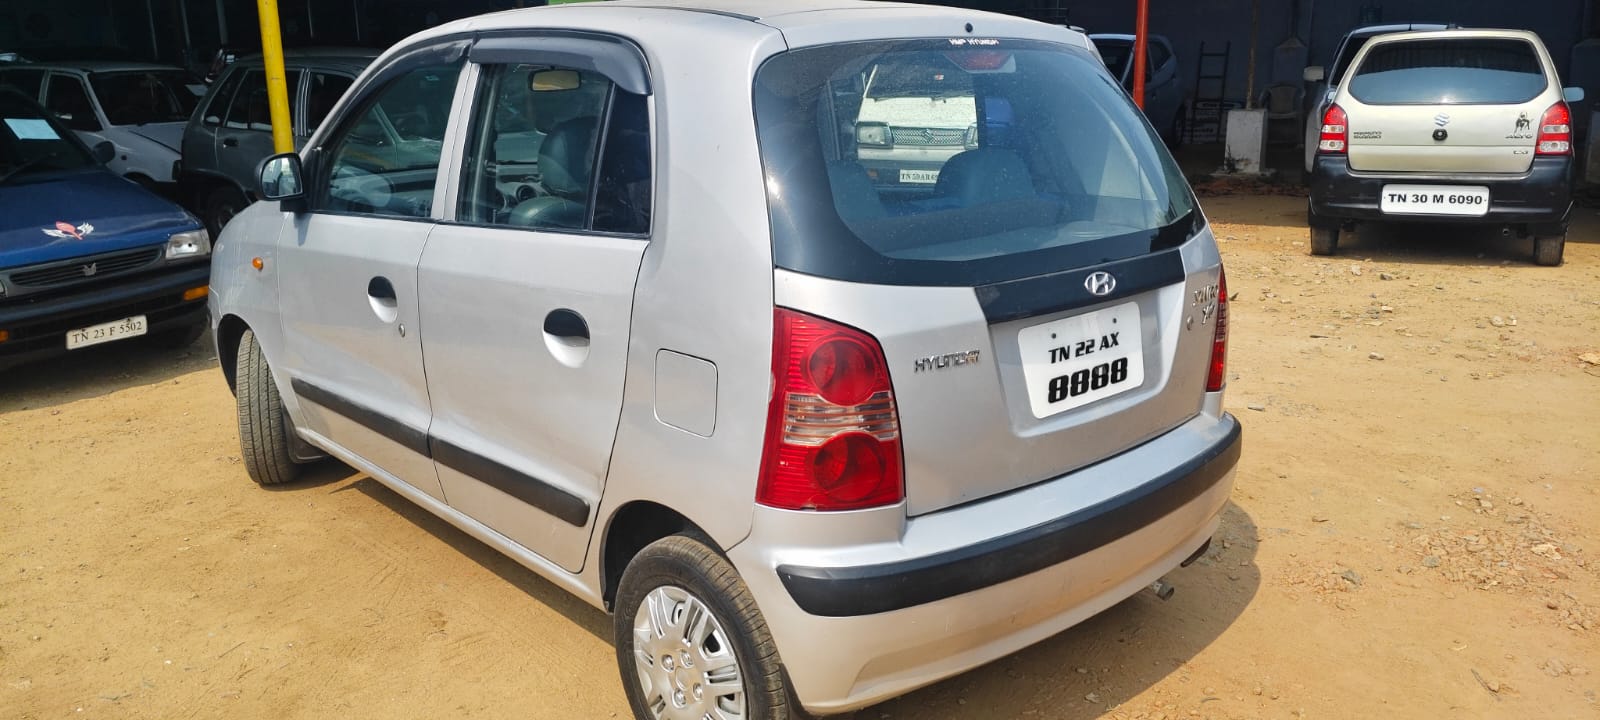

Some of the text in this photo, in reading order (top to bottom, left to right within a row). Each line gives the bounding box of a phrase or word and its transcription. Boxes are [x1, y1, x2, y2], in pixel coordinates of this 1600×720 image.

[1388, 193, 1483, 205] TN 30 M 6090
[72, 321, 142, 344] TN 23 F 5502
[1048, 331, 1120, 364] TN 22 AX
[1047, 356, 1128, 404] 8888
